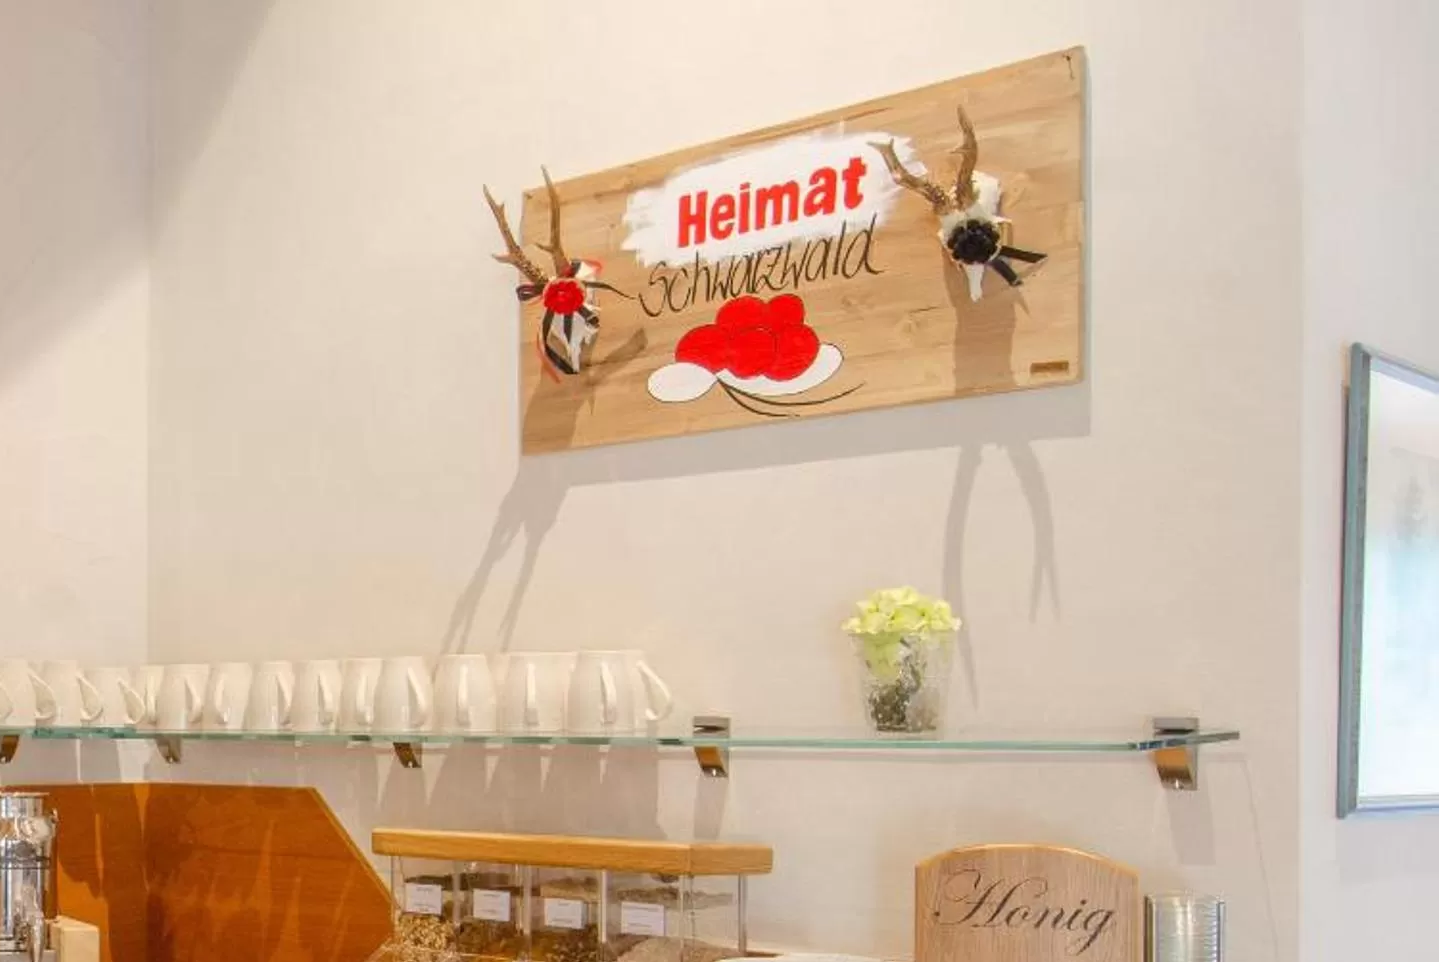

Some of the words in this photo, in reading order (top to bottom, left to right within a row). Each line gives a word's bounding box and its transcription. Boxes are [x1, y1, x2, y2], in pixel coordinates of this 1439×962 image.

[676, 156, 868, 248] Heimat
[639, 212, 884, 317] Schwarzwald
[933, 868, 1117, 956] Honig
